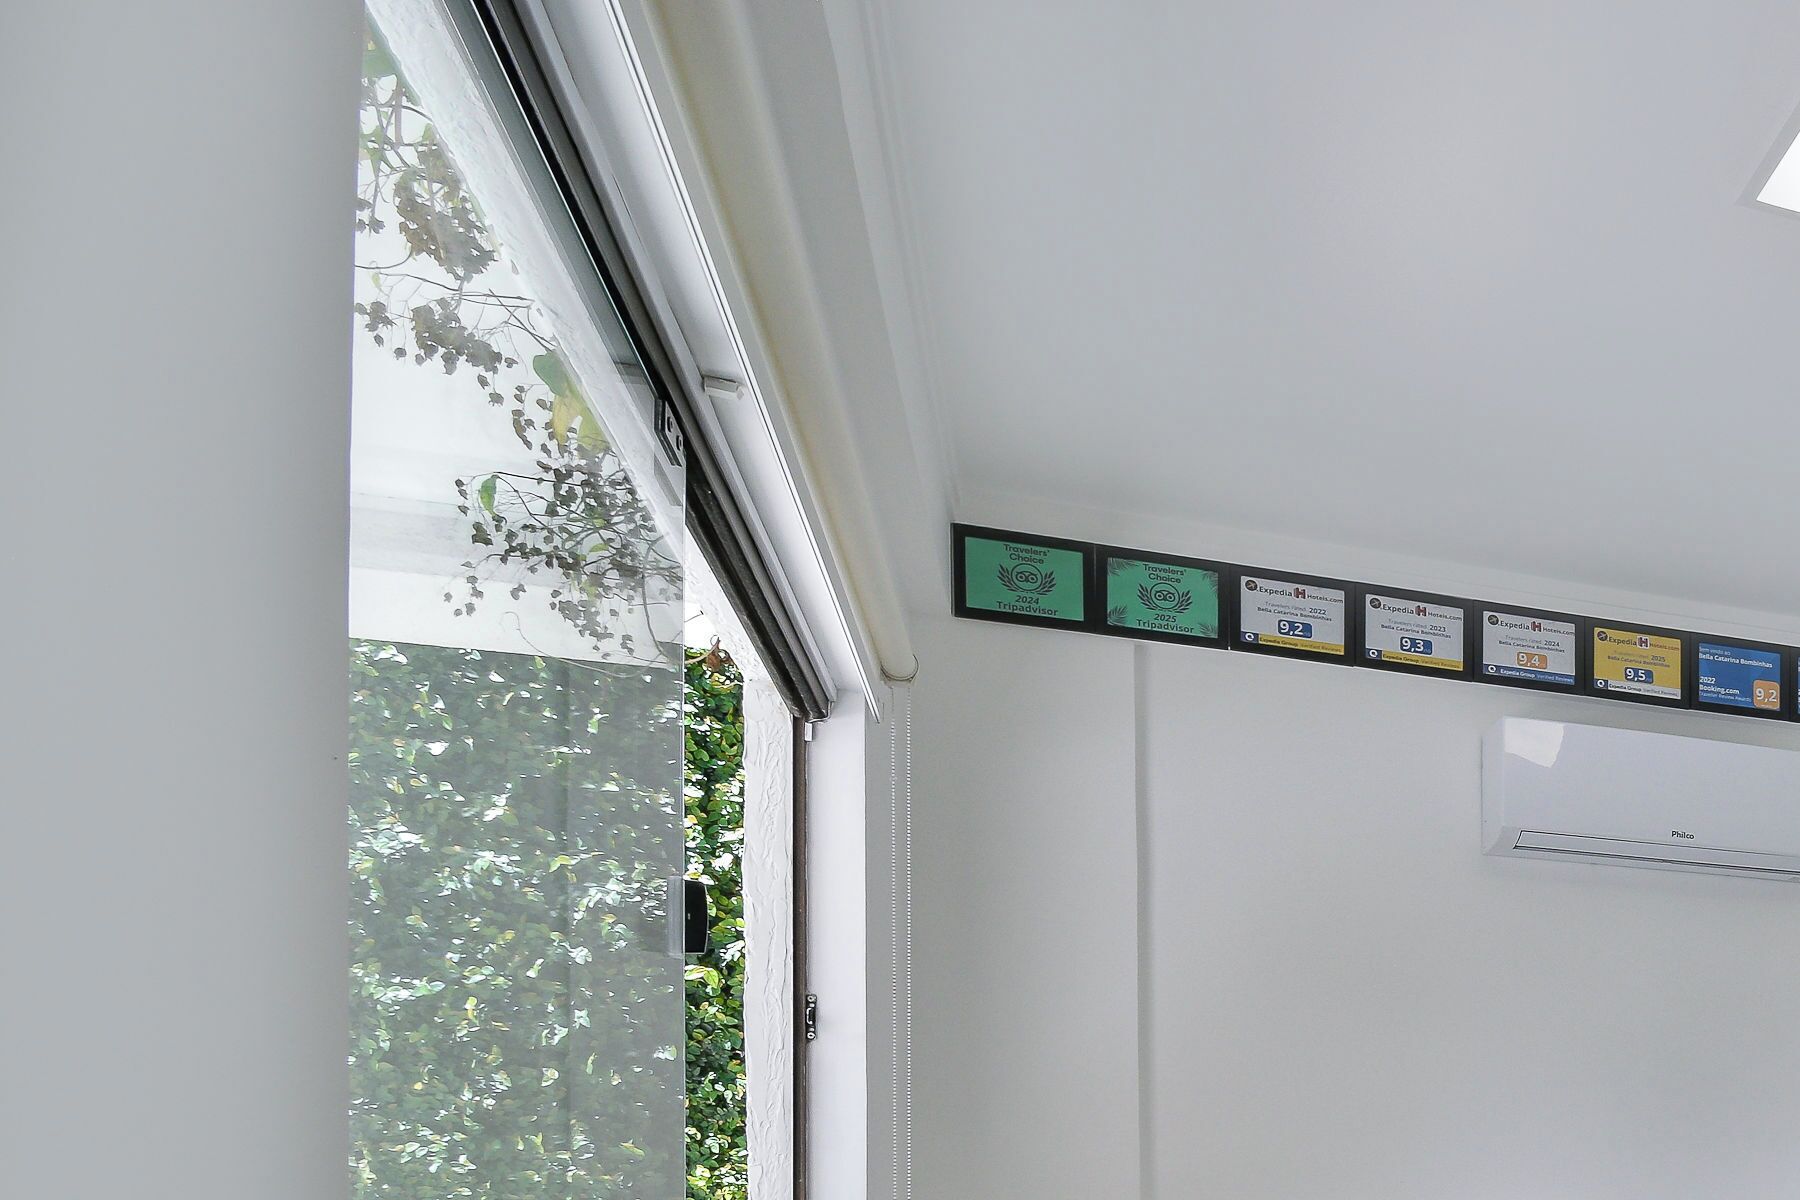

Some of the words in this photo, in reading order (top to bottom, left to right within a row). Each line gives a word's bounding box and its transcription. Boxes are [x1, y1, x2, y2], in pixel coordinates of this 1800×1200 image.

[1003, 544, 1050, 556] Travelers'
[1009, 553, 1044, 564] Choice
[1143, 563, 1186, 576] Travelers'
[1148, 573, 1181, 583] Choice
[1260, 586, 1292, 597] Expedia
[1015, 595, 1040, 604] 2024
[997, 601, 1058, 616] Tripadvisor
[1309, 607, 1326, 615] 2022
[1383, 604, 1414, 614] Expedia
[1154, 613, 1176, 622] 2025
[1136, 619, 1194, 633] Tripadvisor
[1280, 621, 1303, 635] 9,2
[1430, 624, 1446, 632] 2023
[1500, 621, 1530, 630] Expedia
[1402, 638, 1424, 652] 9,3
[1609, 636, 1637, 646] Expedia
[1519, 653, 1540, 666] 9,4
[1714, 655, 1739, 664] Catarina
[1626, 668, 1646, 681] 9,5
[1700, 676, 1716, 684] 2022
[1700, 684, 1740, 695] Booking.com
[1756, 688, 1776, 702] 9,2
[1672, 830, 1694, 839] Philco
